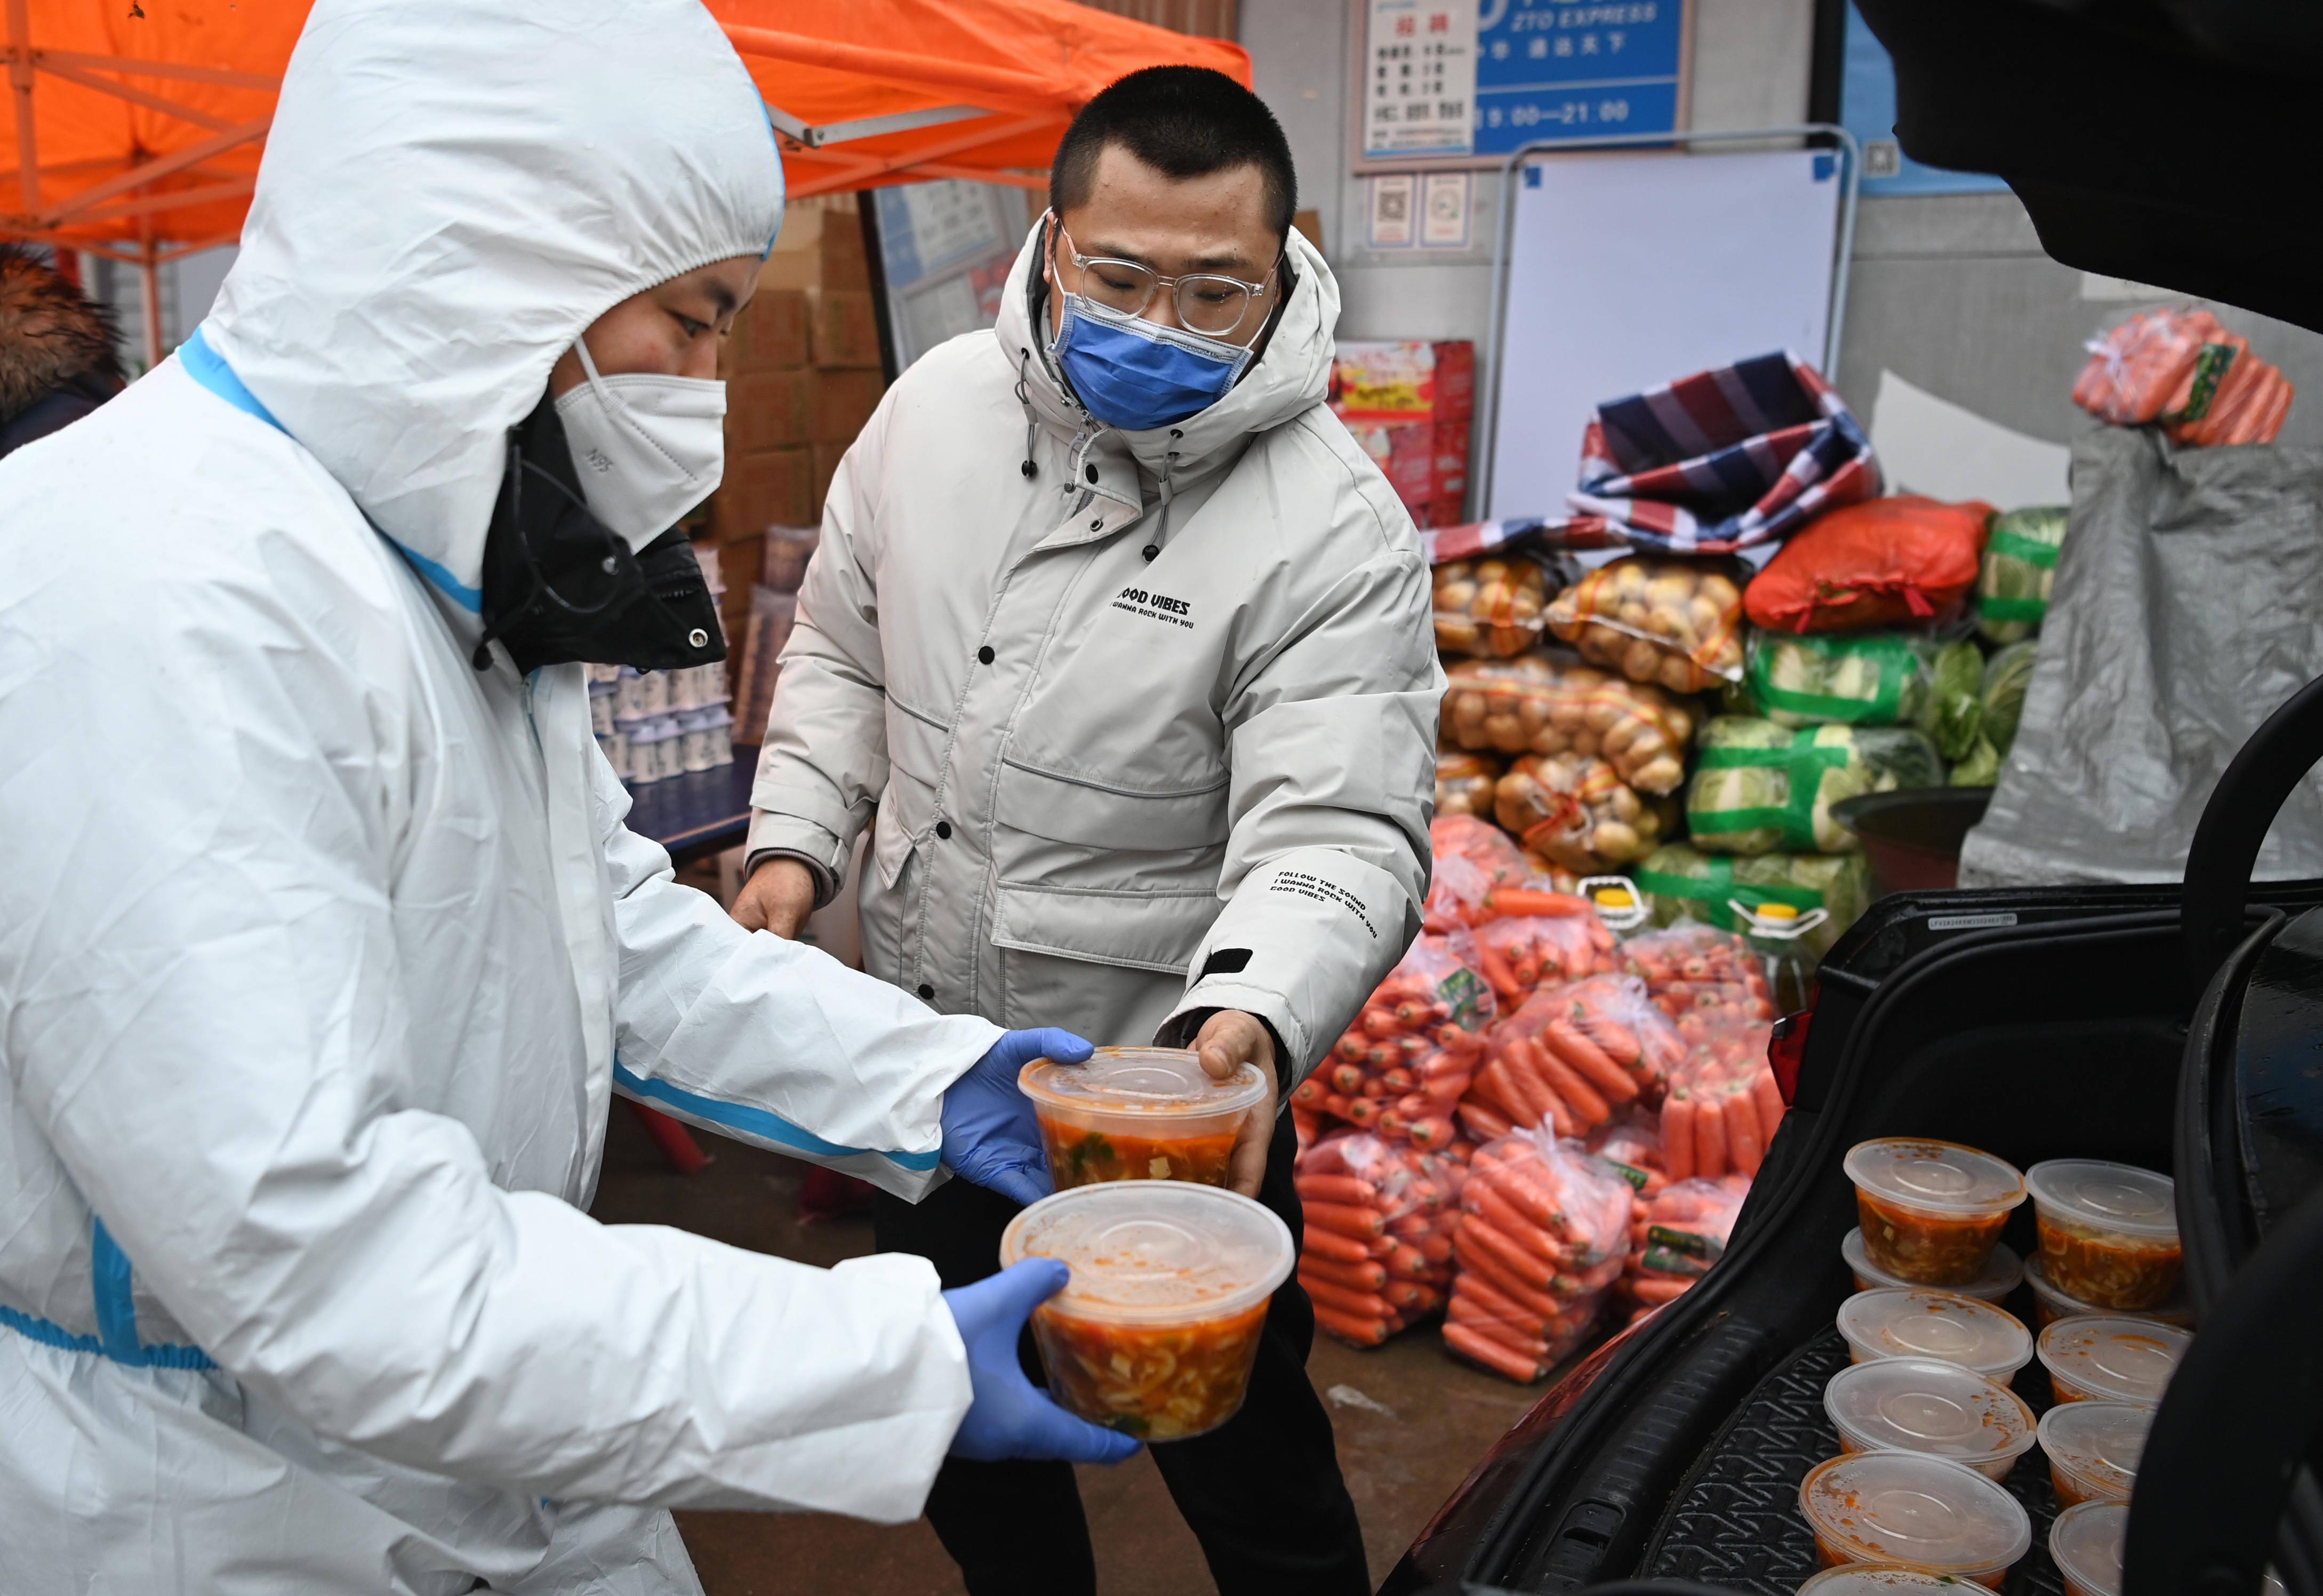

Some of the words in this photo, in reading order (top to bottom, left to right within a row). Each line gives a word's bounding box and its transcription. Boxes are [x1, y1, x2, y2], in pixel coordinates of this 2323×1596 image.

[1511, 11, 1555, 32] ZTO
[1558, 3, 1657, 27] EXPRESS
[584, 448, 614, 474] N95
[1112, 601, 1136, 613] WANNA
[1138, 608, 1157, 619] ROCK
[1158, 613, 1179, 625] WITH
[1180, 619, 1194, 629] YOU
[1116, 587, 1149, 604] OOD
[1150, 594, 1191, 616] VIBES
[1278, 871, 1317, 882] FOLLOW
[1319, 879, 1337, 891] THE
[1338, 888, 1366, 911] SOUND
[1298, 888, 1326, 902] VIBES
[1280, 879, 1315, 890] WANNA
[1317, 887, 1343, 903] ROCK
[1344, 900, 1366, 921] WITH
[1365, 920, 1377, 939] YOU
